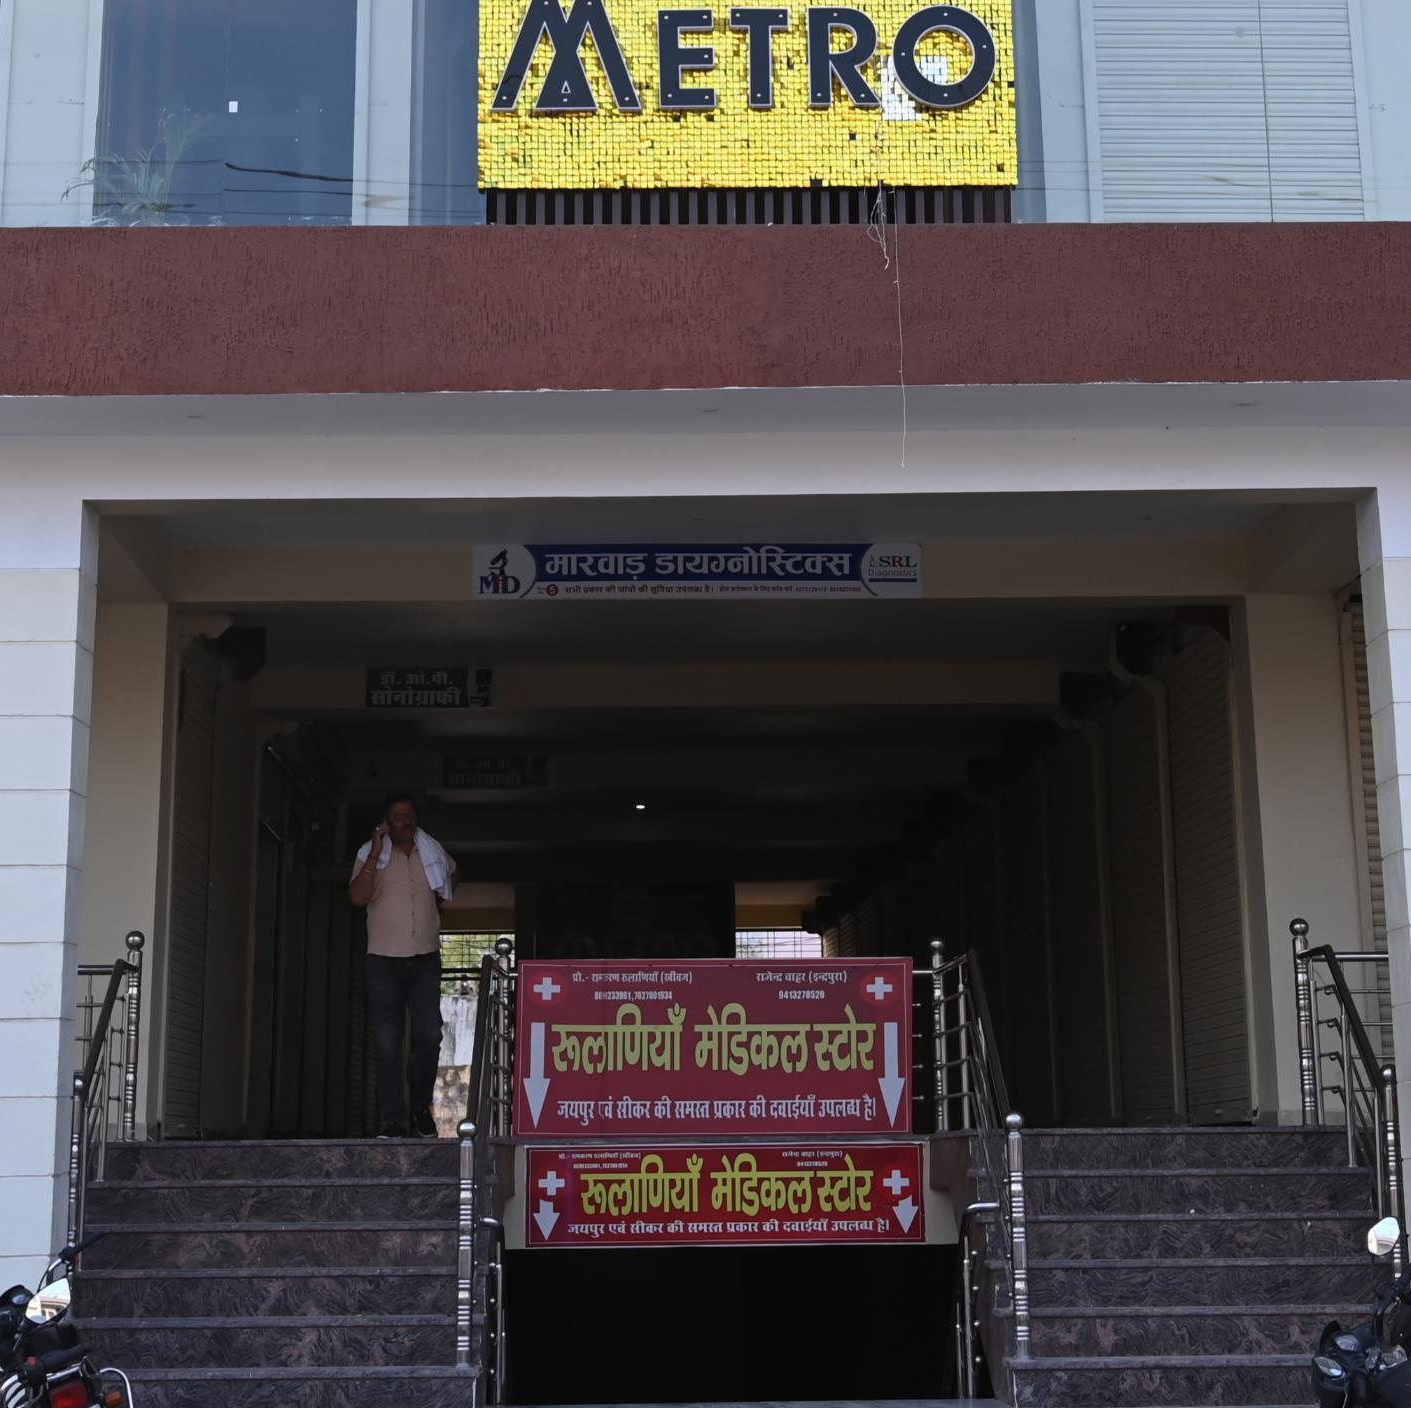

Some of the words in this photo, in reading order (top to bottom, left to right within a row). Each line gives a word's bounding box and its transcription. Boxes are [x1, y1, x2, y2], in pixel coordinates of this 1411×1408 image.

[544, 553, 648, 580] मारवाड़
[654, 545, 852, 576] डायग्नोस्टिक्स
[879, 555, 918, 568] SRL
[551, 1002, 687, 1074] रूलाणियाँ
[694, 1003, 811, 1076] मेडिकल
[813, 1004, 876, 1073] स्टोर
[557, 1099, 595, 1126] जयपुर
[616, 1094, 651, 1120] सीकर
[654, 1094, 673, 1119] की
[674, 1100, 712, 1119] समस्त
[713, 1100, 746, 1120] प्रकार
[749, 1094, 768, 1119] की
[770, 1093, 816, 1119] दवाईयाँ
[818, 1098, 861, 1118] उपलब्ध
[579, 1153, 702, 1215] रूलाणियाँ
[710, 1152, 816, 1217] मेडिकल
[817, 1153, 874, 1213] स्टोर
[567, 1223, 606, 1239] जयपुर
[609, 1221, 627, 1234] एवं
[630, 1220, 664, 1234] सीकर
[667, 1220, 685, 1233] की
[687, 1223, 723, 1233] समस्त
[726, 1223, 760, 1234] प्रकार
[762, 1220, 780, 1233] की
